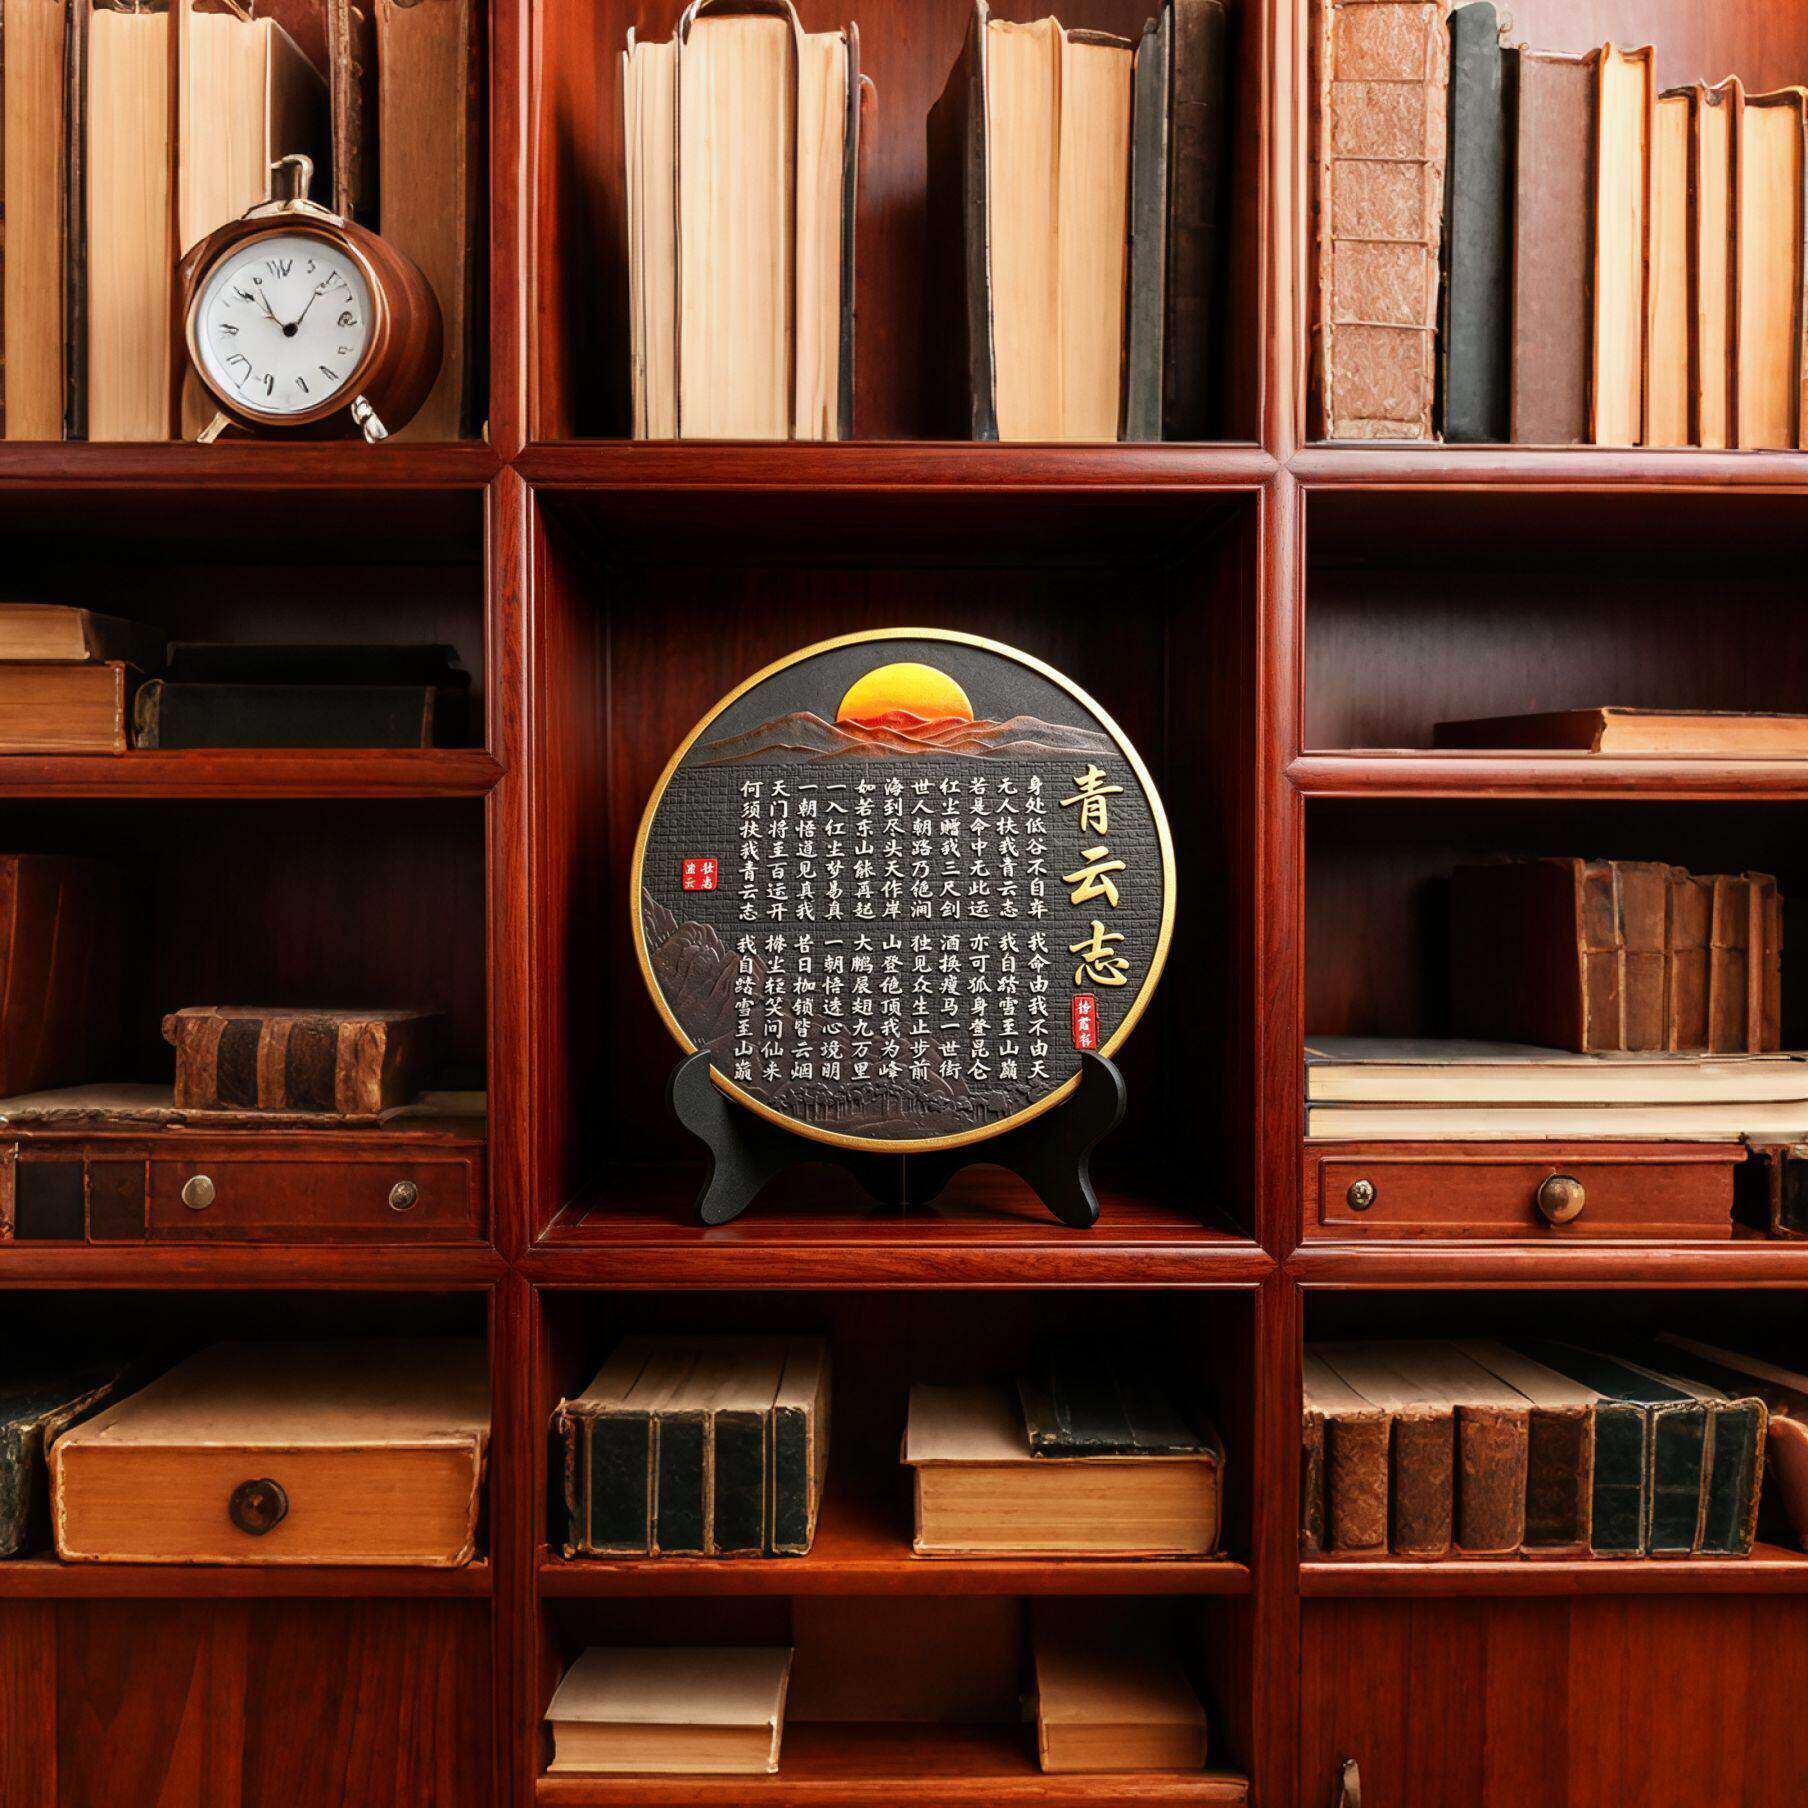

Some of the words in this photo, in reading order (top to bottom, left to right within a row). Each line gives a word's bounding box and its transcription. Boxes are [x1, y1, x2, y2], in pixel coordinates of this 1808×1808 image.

[738, 780, 764, 921] 何须扶我青云志
[766, 779, 791, 922] 天门将至百运开
[794, 784, 819, 921] 一朝悟道见真我
[824, 784, 849, 920] 一入红尘梦易真
[852, 778, 877, 920] 如若东山能再起
[880, 776, 906, 919] 海到尽头天作岸
[939, 777, 962, 919] 红尘赠我三尺剑
[967, 776, 992, 918] 若是命中无此运
[995, 776, 1020, 918] 无人扶我青云志
[1024, 774, 1049, 920] 身处低谷不自弃
[1059, 764, 1130, 987] 青云志
[734, 933, 757, 1081] 我自踏雪至山巅
[820, 939, 845, 1081] 一朝悟透心境明
[850, 933, 875, 1080] 大鹏展翅九万里
[878, 933, 904, 1079] 山登绝顶我为峰
[908, 933, 933, 1081] 独见众生止步前
[996, 931, 1020, 1080] 我自踏雪至山巅
[1027, 931, 1051, 1079] 我命由我不由天
